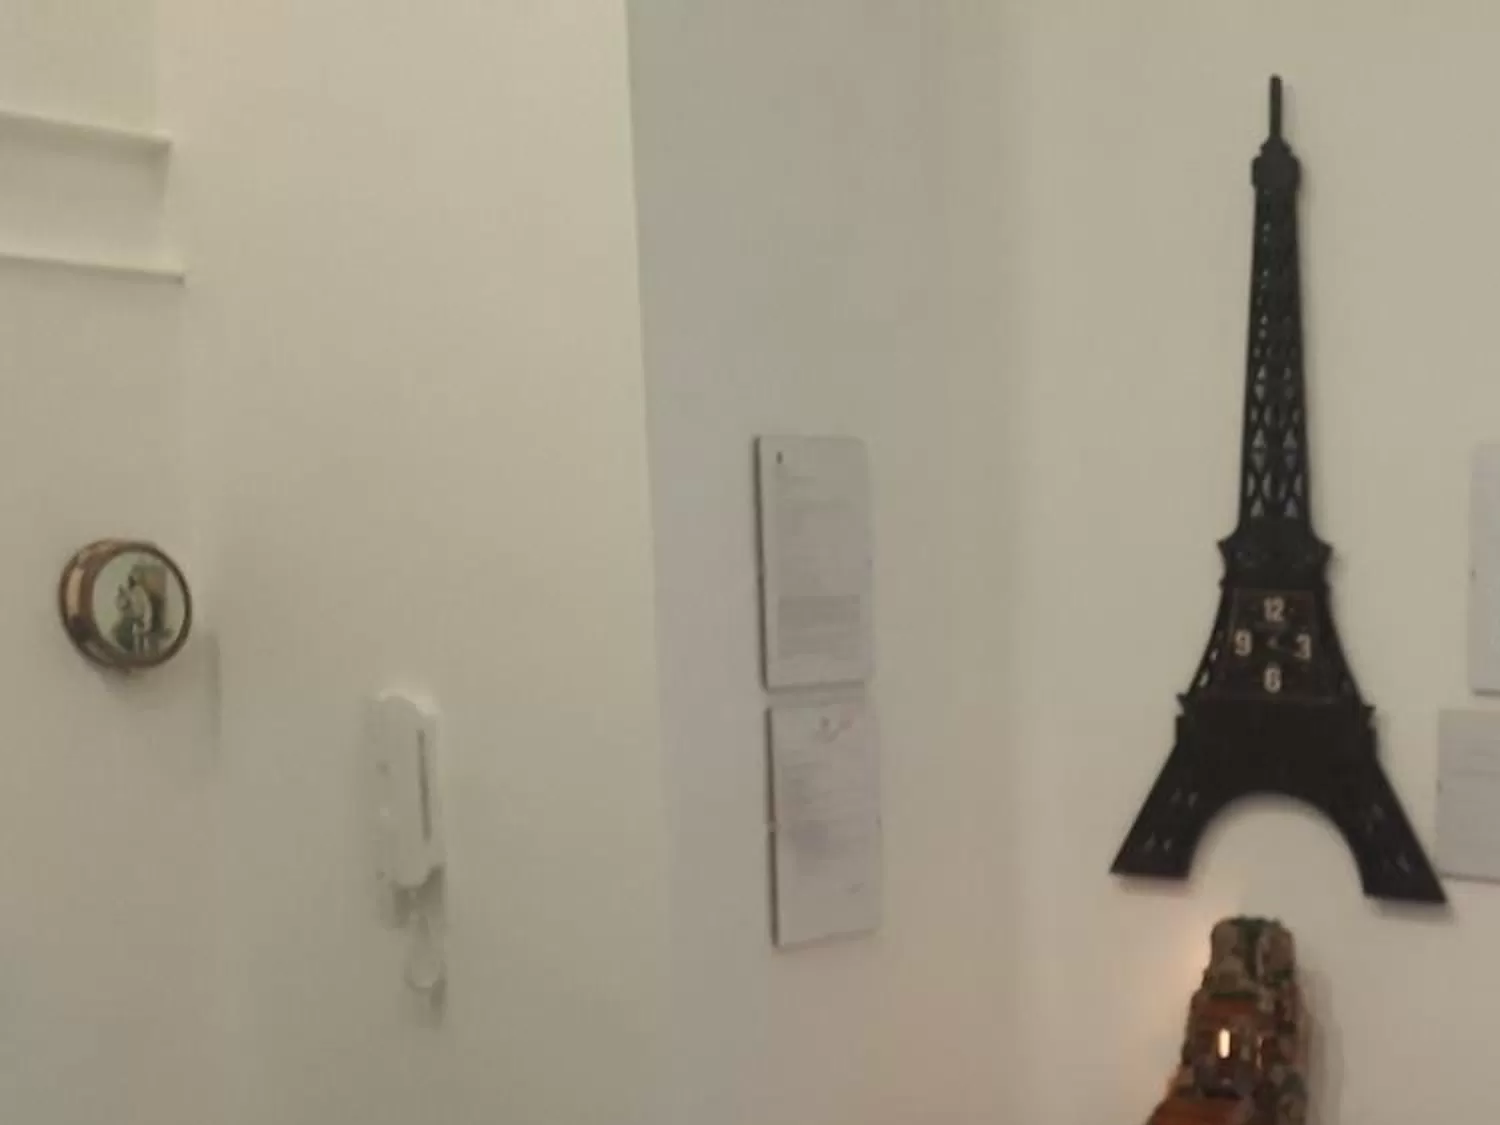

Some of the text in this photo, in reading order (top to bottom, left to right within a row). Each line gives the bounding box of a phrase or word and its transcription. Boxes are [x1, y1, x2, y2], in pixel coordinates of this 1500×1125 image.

[1264, 596, 1285, 621] 12
[1234, 629, 1253, 656] 9
[1292, 632, 1313, 660] 3
[1263, 666, 1282, 693] 6
